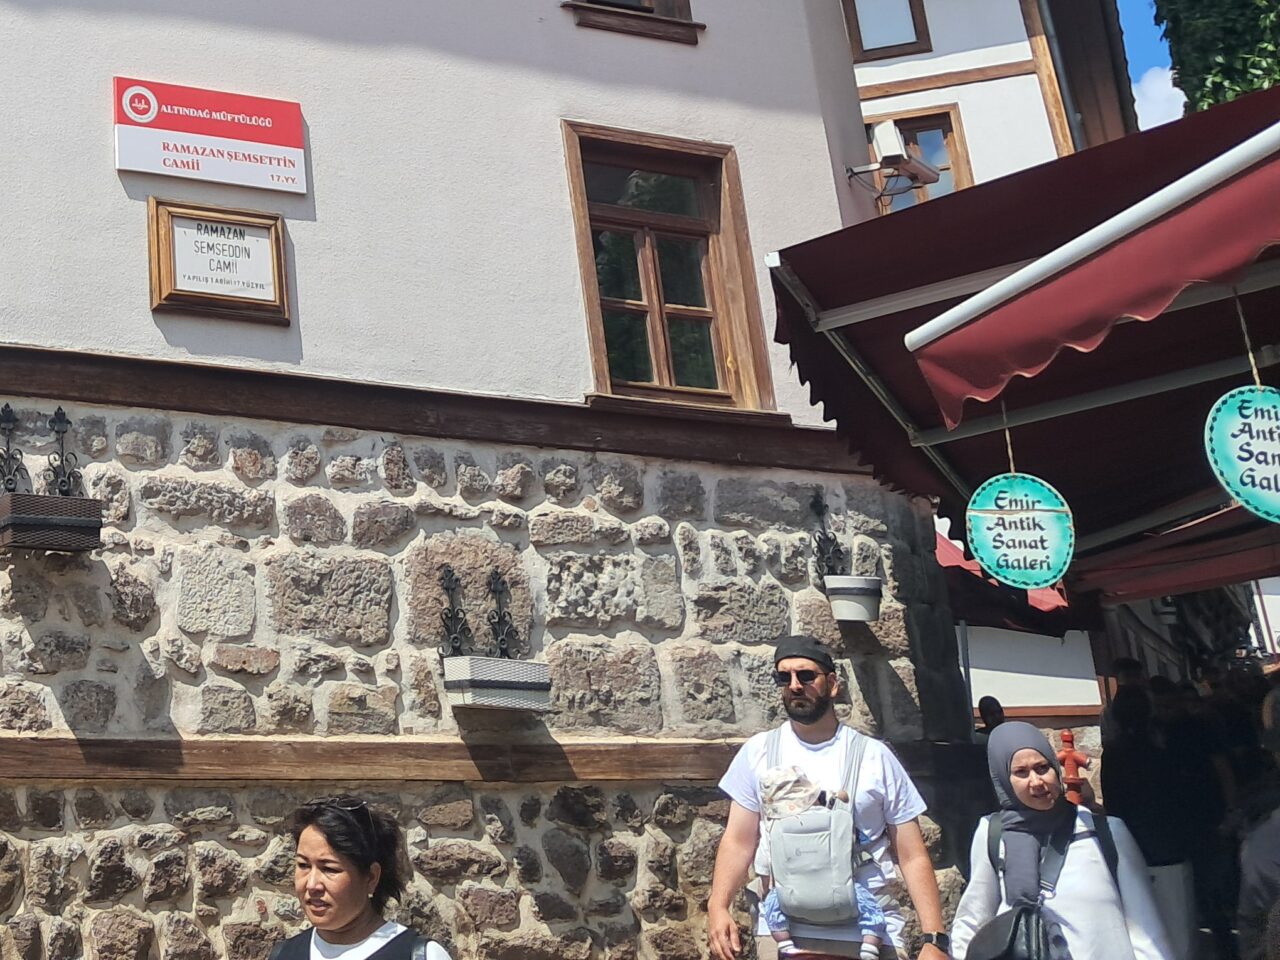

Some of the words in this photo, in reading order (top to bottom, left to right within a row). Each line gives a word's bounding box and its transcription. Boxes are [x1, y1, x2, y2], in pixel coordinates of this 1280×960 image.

[162, 142, 225, 159] RAMAZAN
[196, 223, 246, 241] RAMAZAN
[1237, 399, 1280, 421] Emi
[1230, 422, 1280, 442] Anti
[1236, 441, 1280, 466] San
[1239, 467, 1280, 493] Gal
[994, 490, 1042, 510] Emir
[986, 516, 1046, 531] Antik
[992, 532, 1049, 550] Sanat
[996, 553, 1052, 571] Galeri
